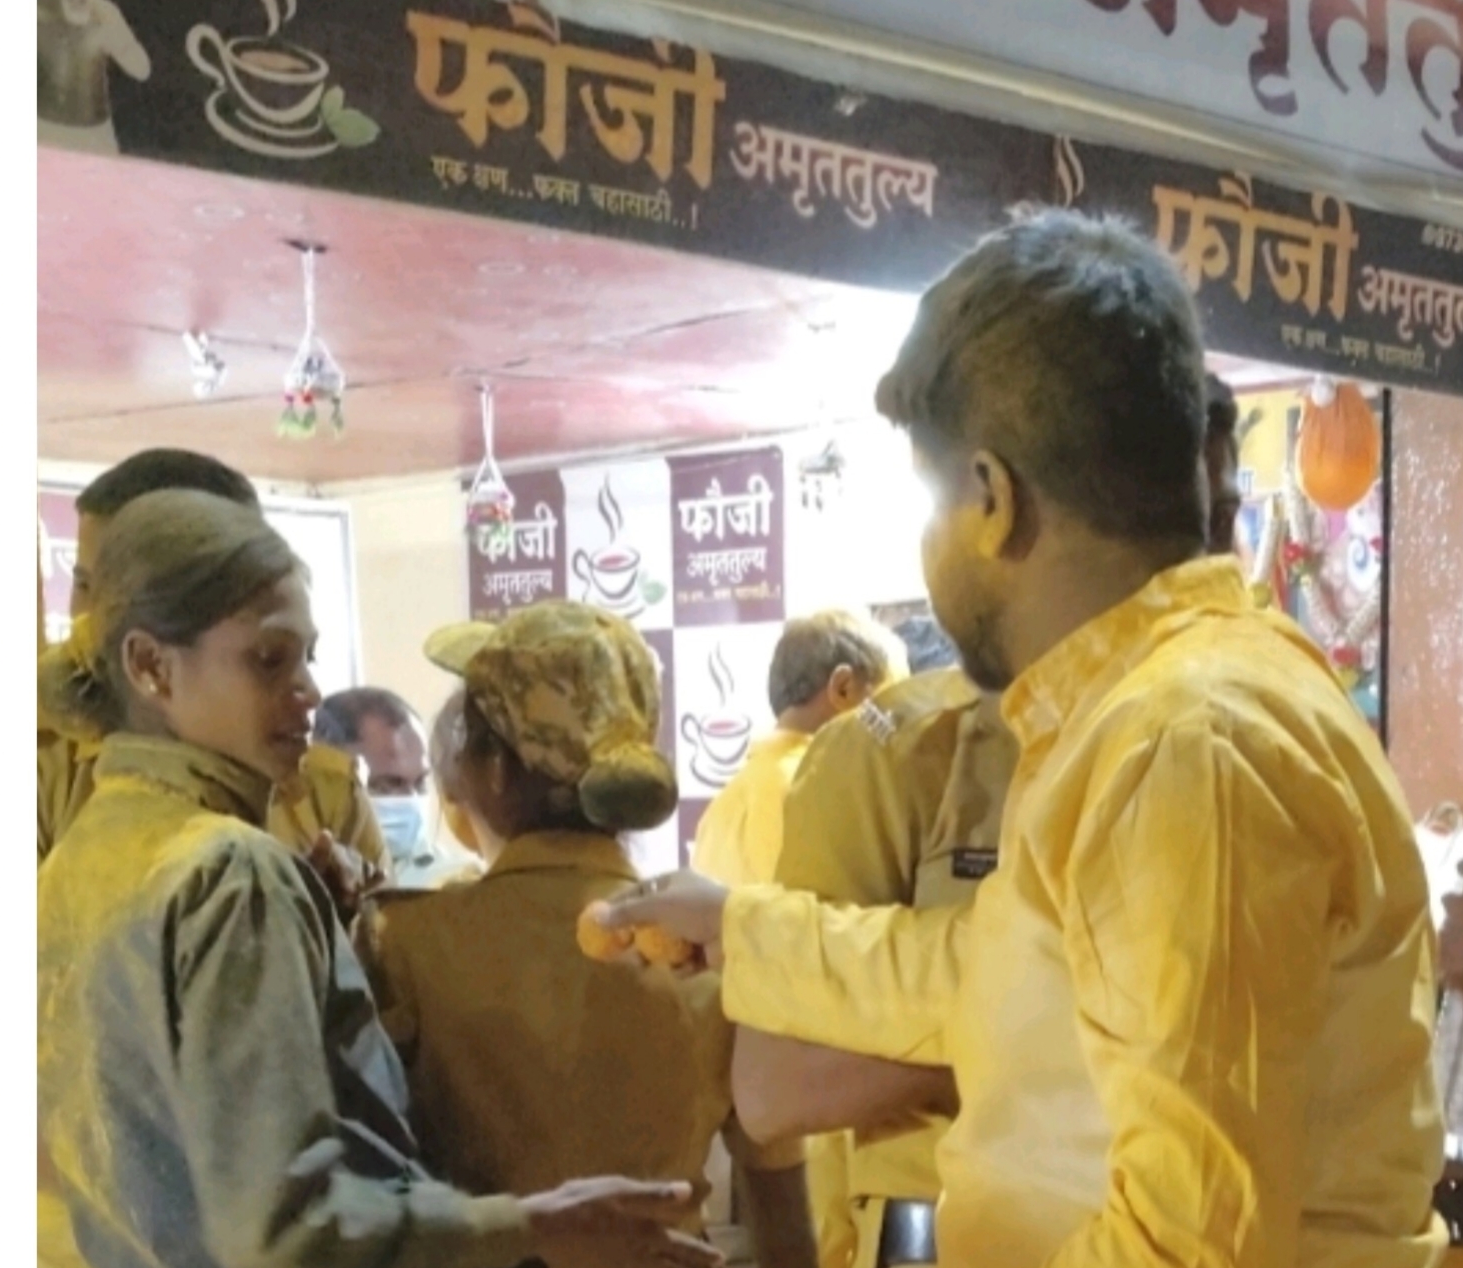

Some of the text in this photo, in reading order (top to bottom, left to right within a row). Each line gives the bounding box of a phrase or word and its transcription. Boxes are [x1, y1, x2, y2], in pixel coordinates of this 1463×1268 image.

[729, 121, 938, 229] अमृततुल्य
[1357, 264, 1463, 348] अमृततु
[678, 475, 773, 542] फौजी
